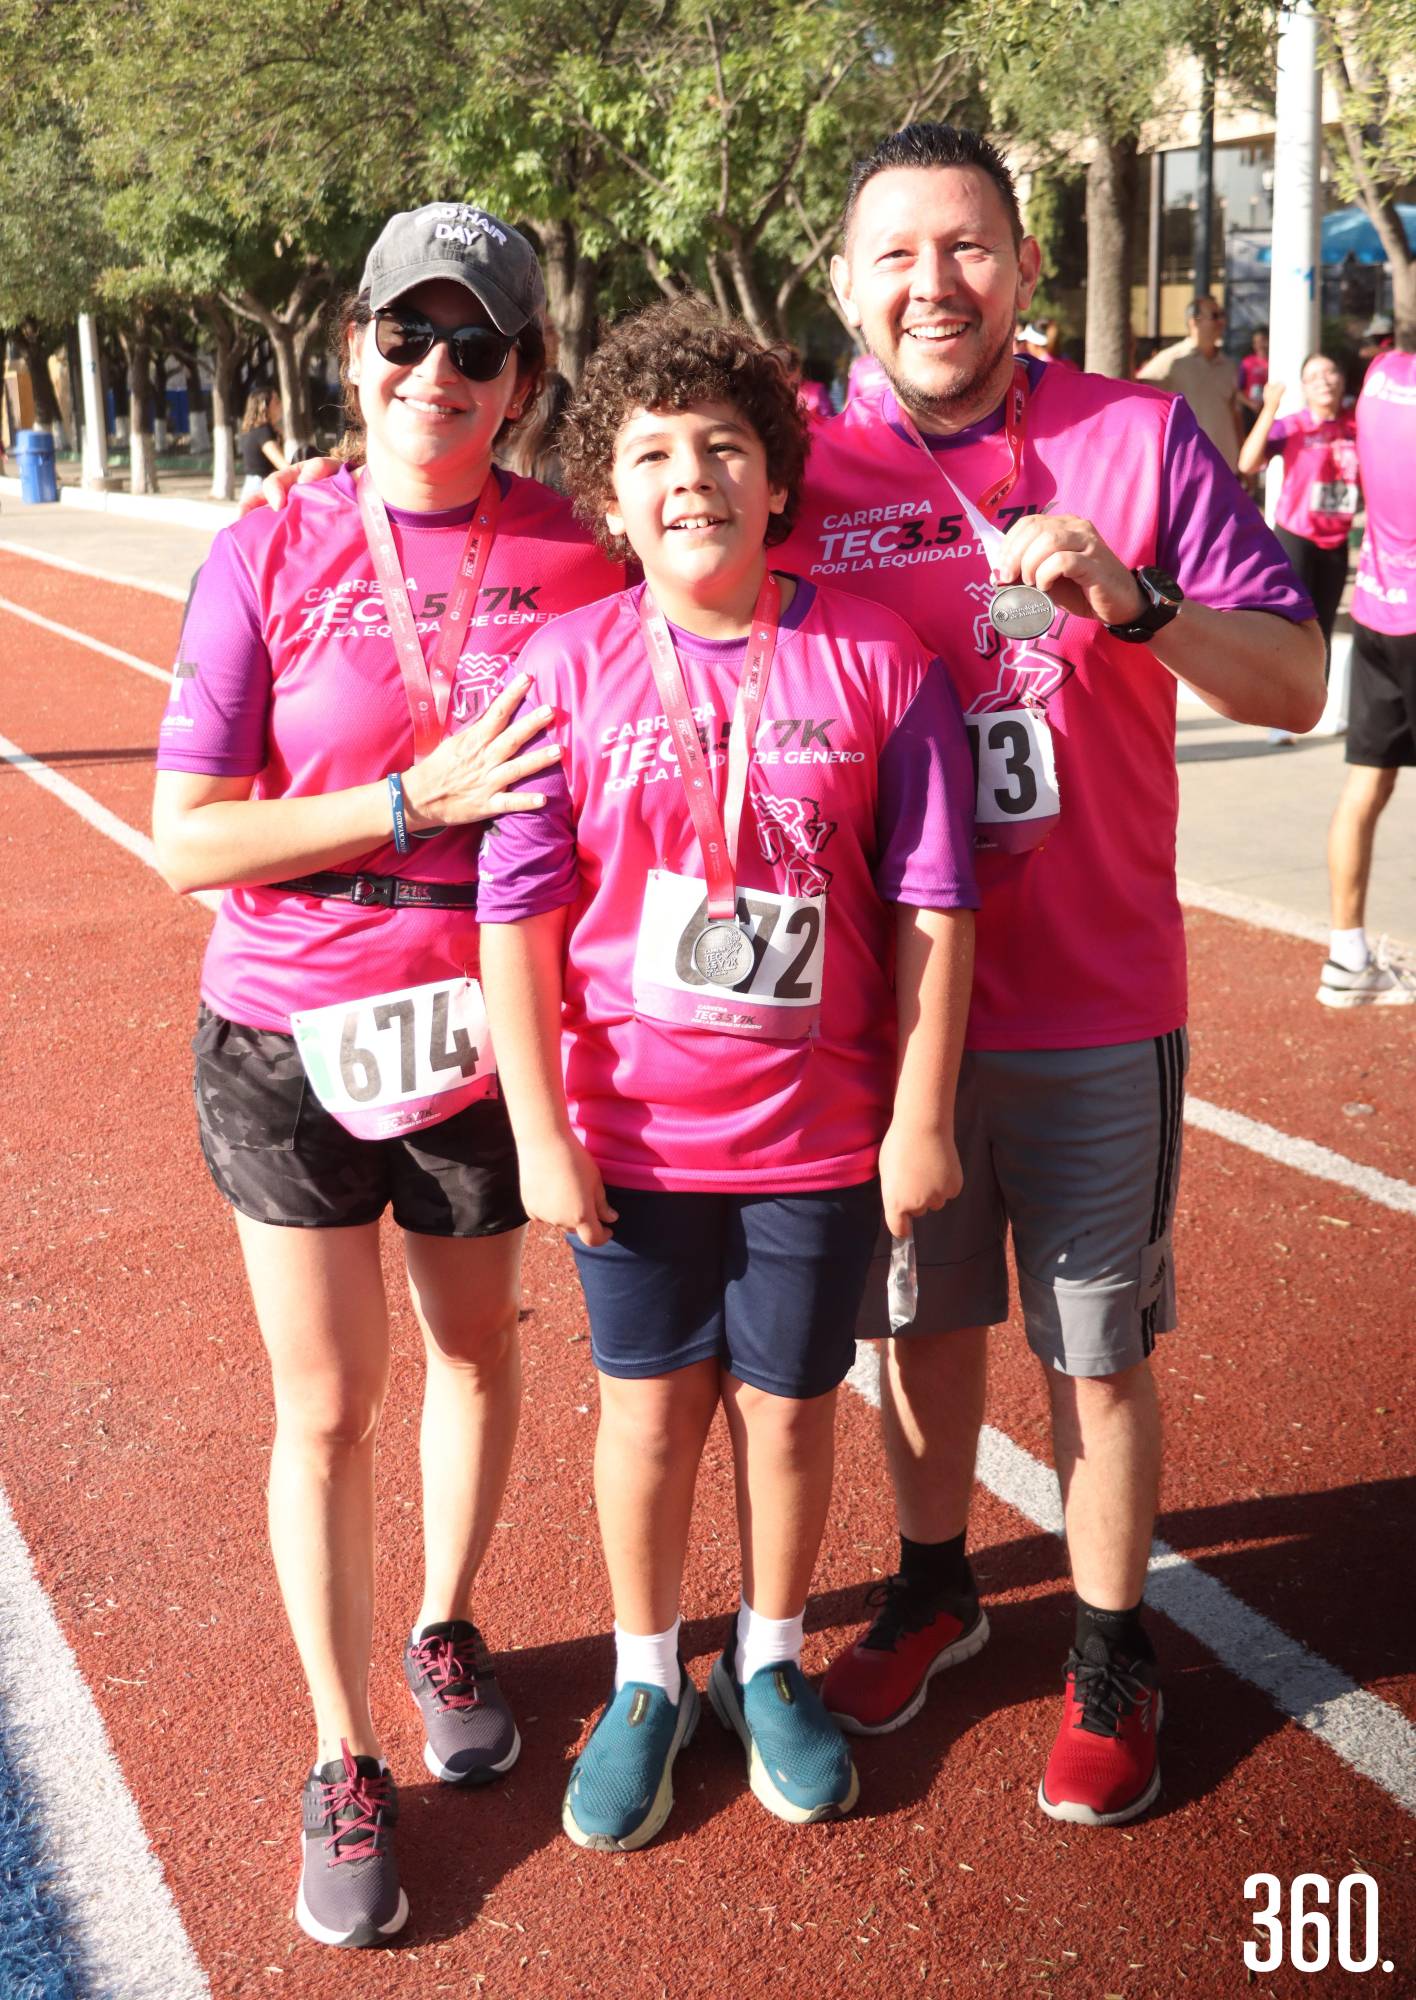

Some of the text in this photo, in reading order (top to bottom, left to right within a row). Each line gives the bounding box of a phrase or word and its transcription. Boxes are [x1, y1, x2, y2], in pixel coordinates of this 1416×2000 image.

[435, 223, 480, 246] DAY
[461, 209, 508, 246] HAIR
[822, 500, 933, 530] CARRERA
[810, 561, 847, 577] POR
[851, 559, 874, 572] LA
[878, 544, 973, 569] EQUIDAD
[304, 577, 418, 602] CARREA
[333, 625, 359, 638] LA
[601, 702, 717, 745] CARRRA
[644, 766, 669, 785] LA
[783, 748, 865, 765] GÉNERO
[339, 990, 479, 1102] 674
